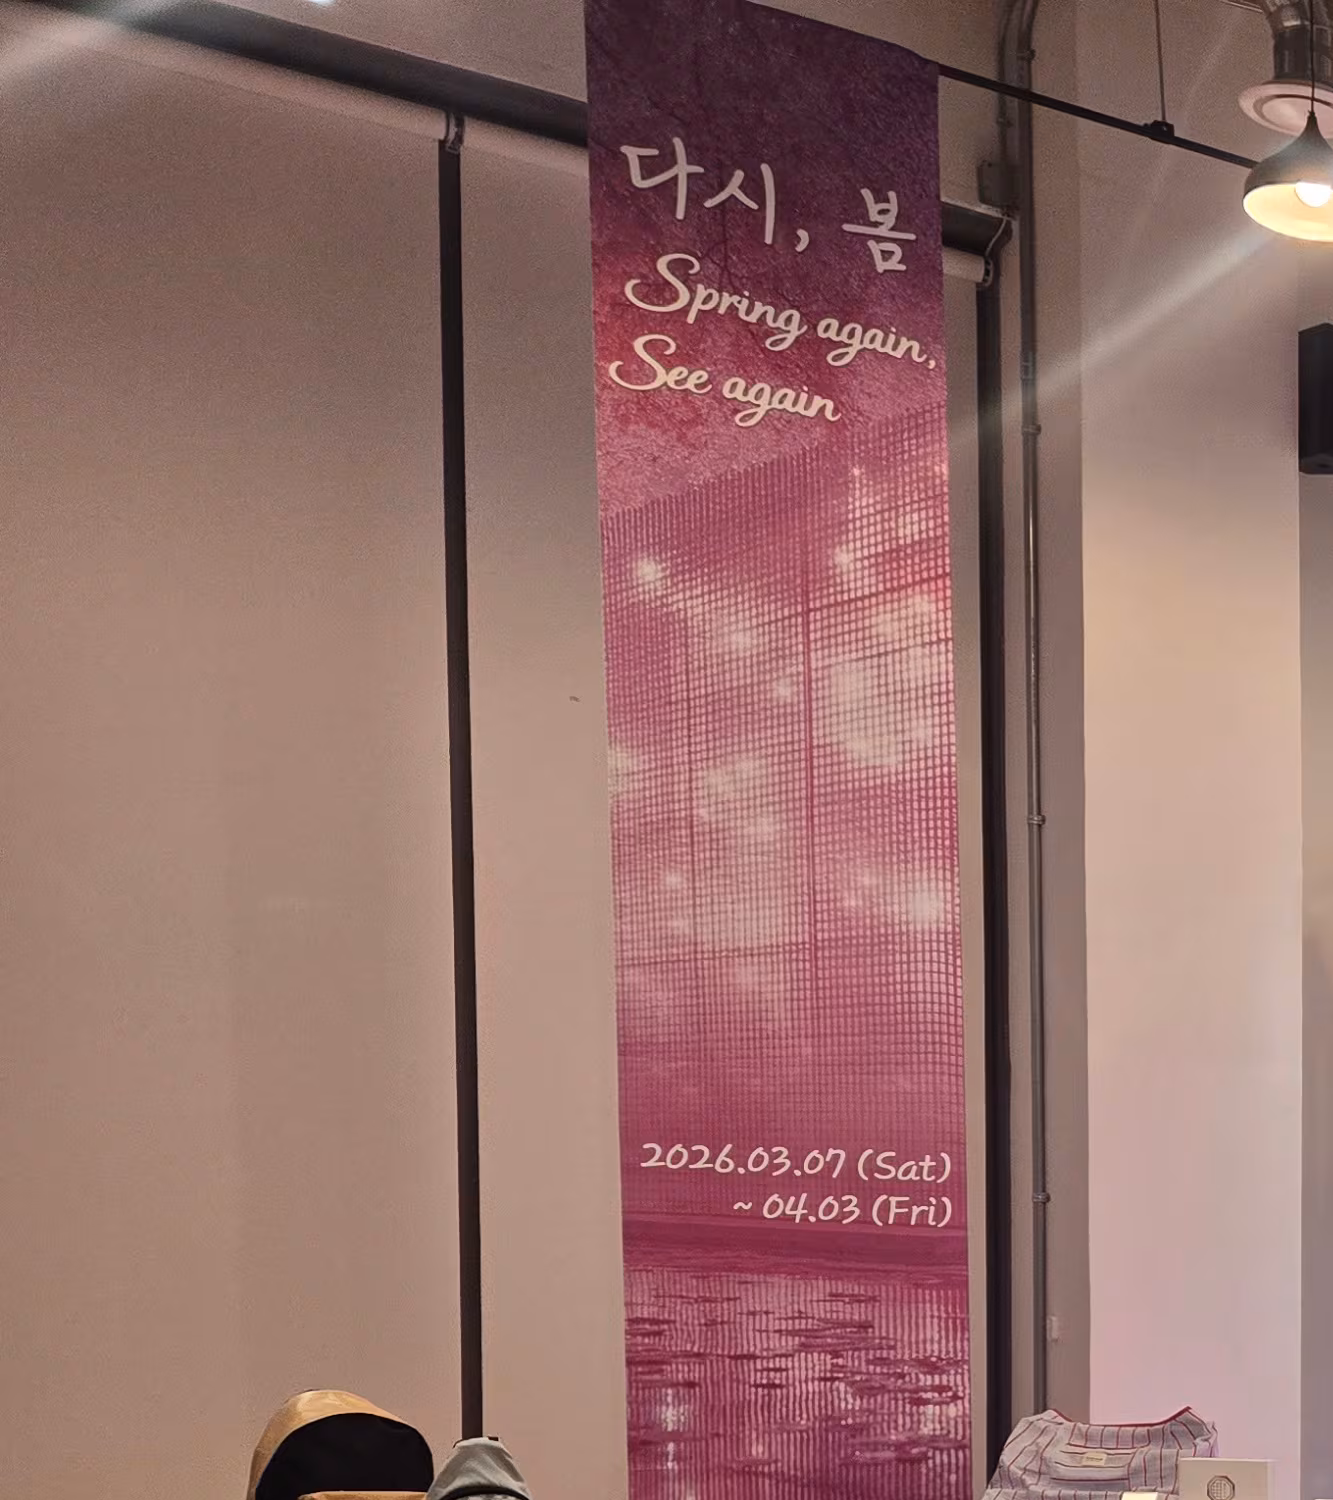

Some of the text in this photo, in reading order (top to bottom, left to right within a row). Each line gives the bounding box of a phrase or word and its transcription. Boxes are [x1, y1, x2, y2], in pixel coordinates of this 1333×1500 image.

[620, 137, 917, 273] 다시, 봄
[624, 253, 937, 369] Spring again,
[608, 334, 841, 427] See again
[640, 1142, 951, 1184] 2026.03.07 (Sat)
[763, 1192, 861, 1224] 04.03
[872, 1194, 952, 1227] (Fri)
